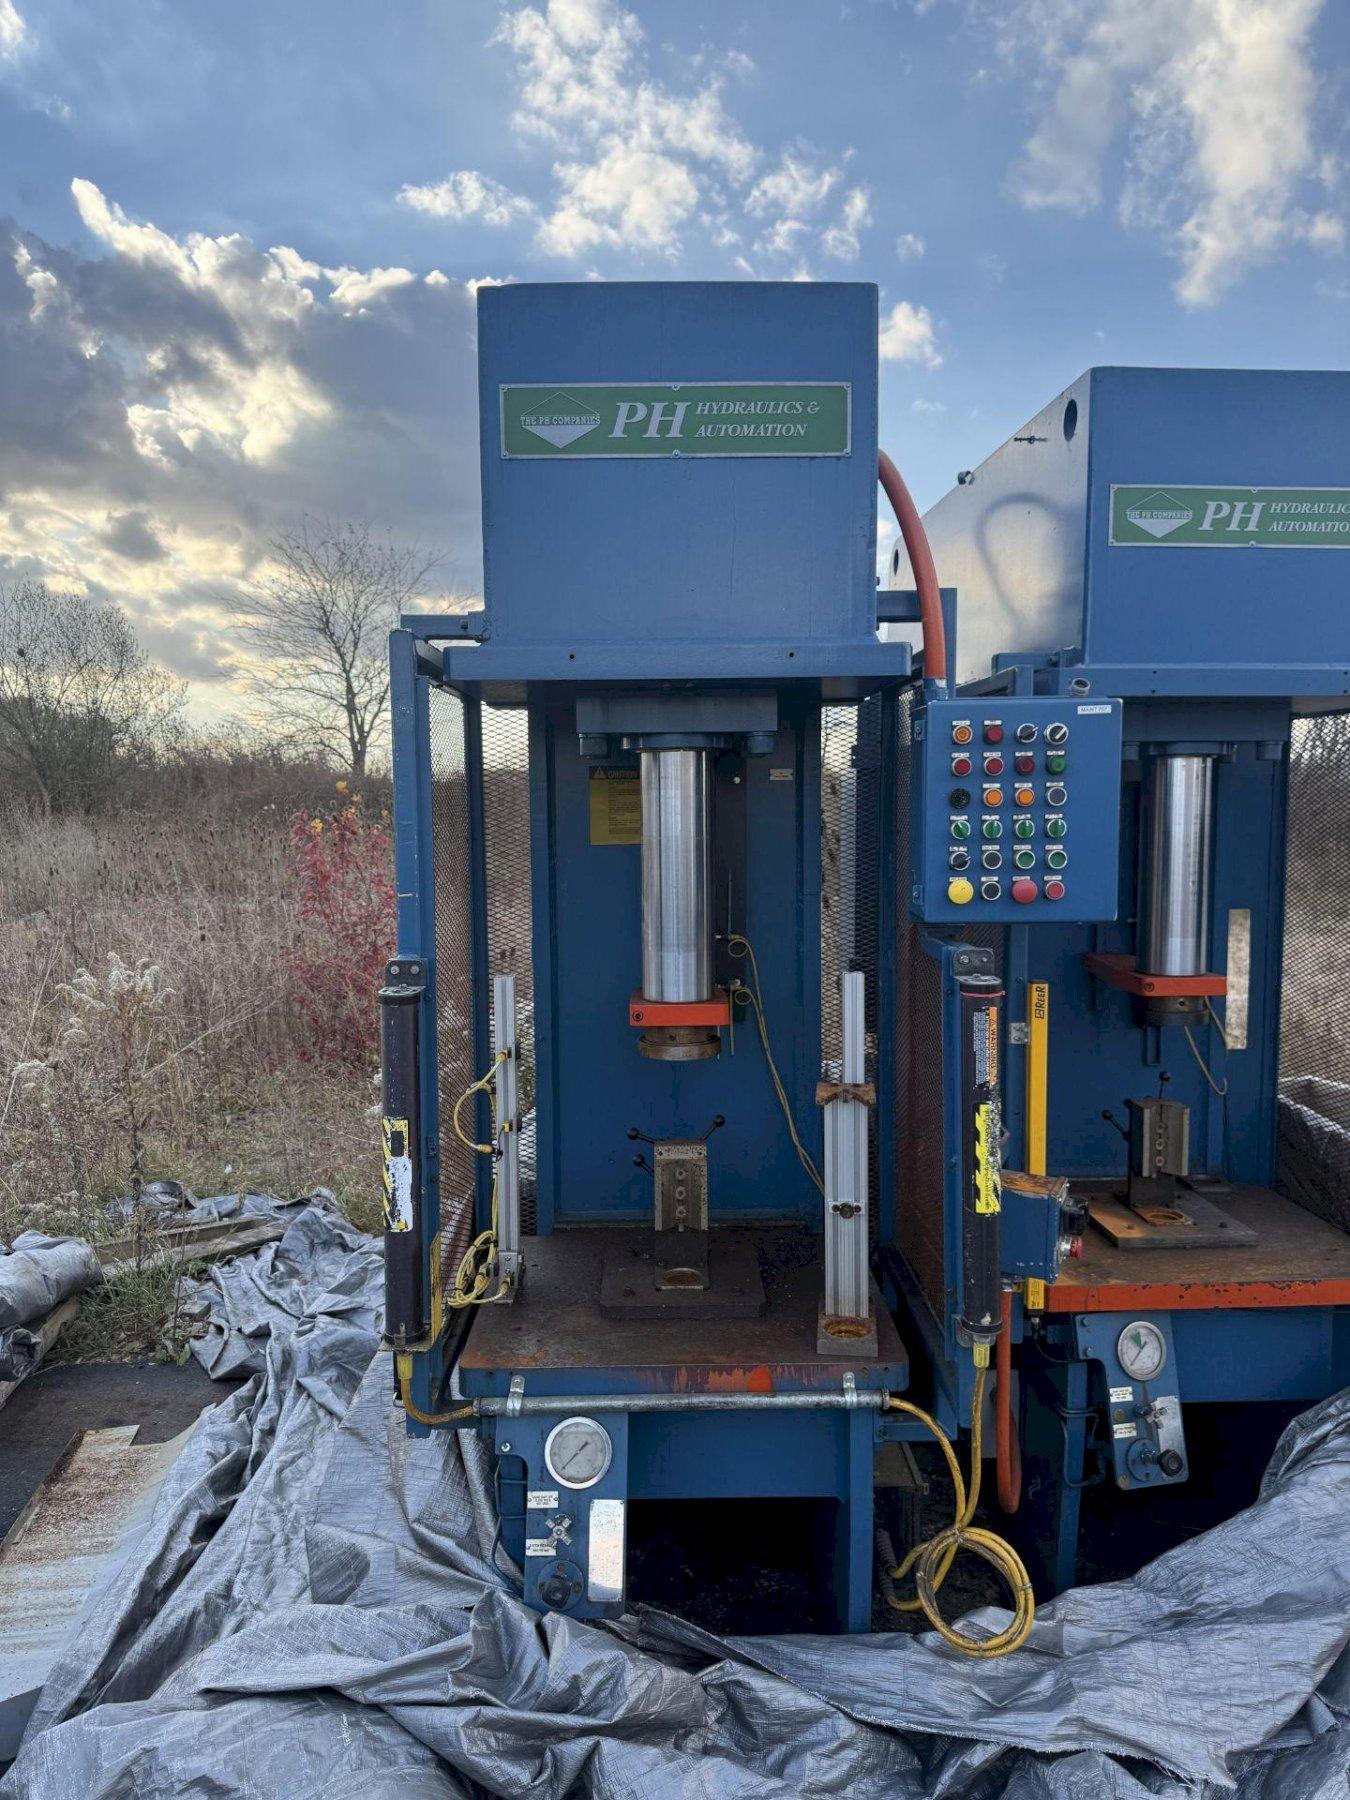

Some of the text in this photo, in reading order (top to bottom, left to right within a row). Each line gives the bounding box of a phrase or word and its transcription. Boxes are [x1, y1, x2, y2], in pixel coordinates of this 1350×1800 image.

[695, 401, 821, 414] HYDRAULICS &
[520, 416, 601, 425] THE PH COMPANIES
[608, 401, 692, 438] PH
[694, 424, 808, 438] AUTOMATION
[1269, 502, 1350, 514] HYDRAULIC
[1152, 511, 1193, 519] COMPANIES
[1198, 501, 1266, 532] PH
[1267, 520, 1350, 532] AUTOMATIO
